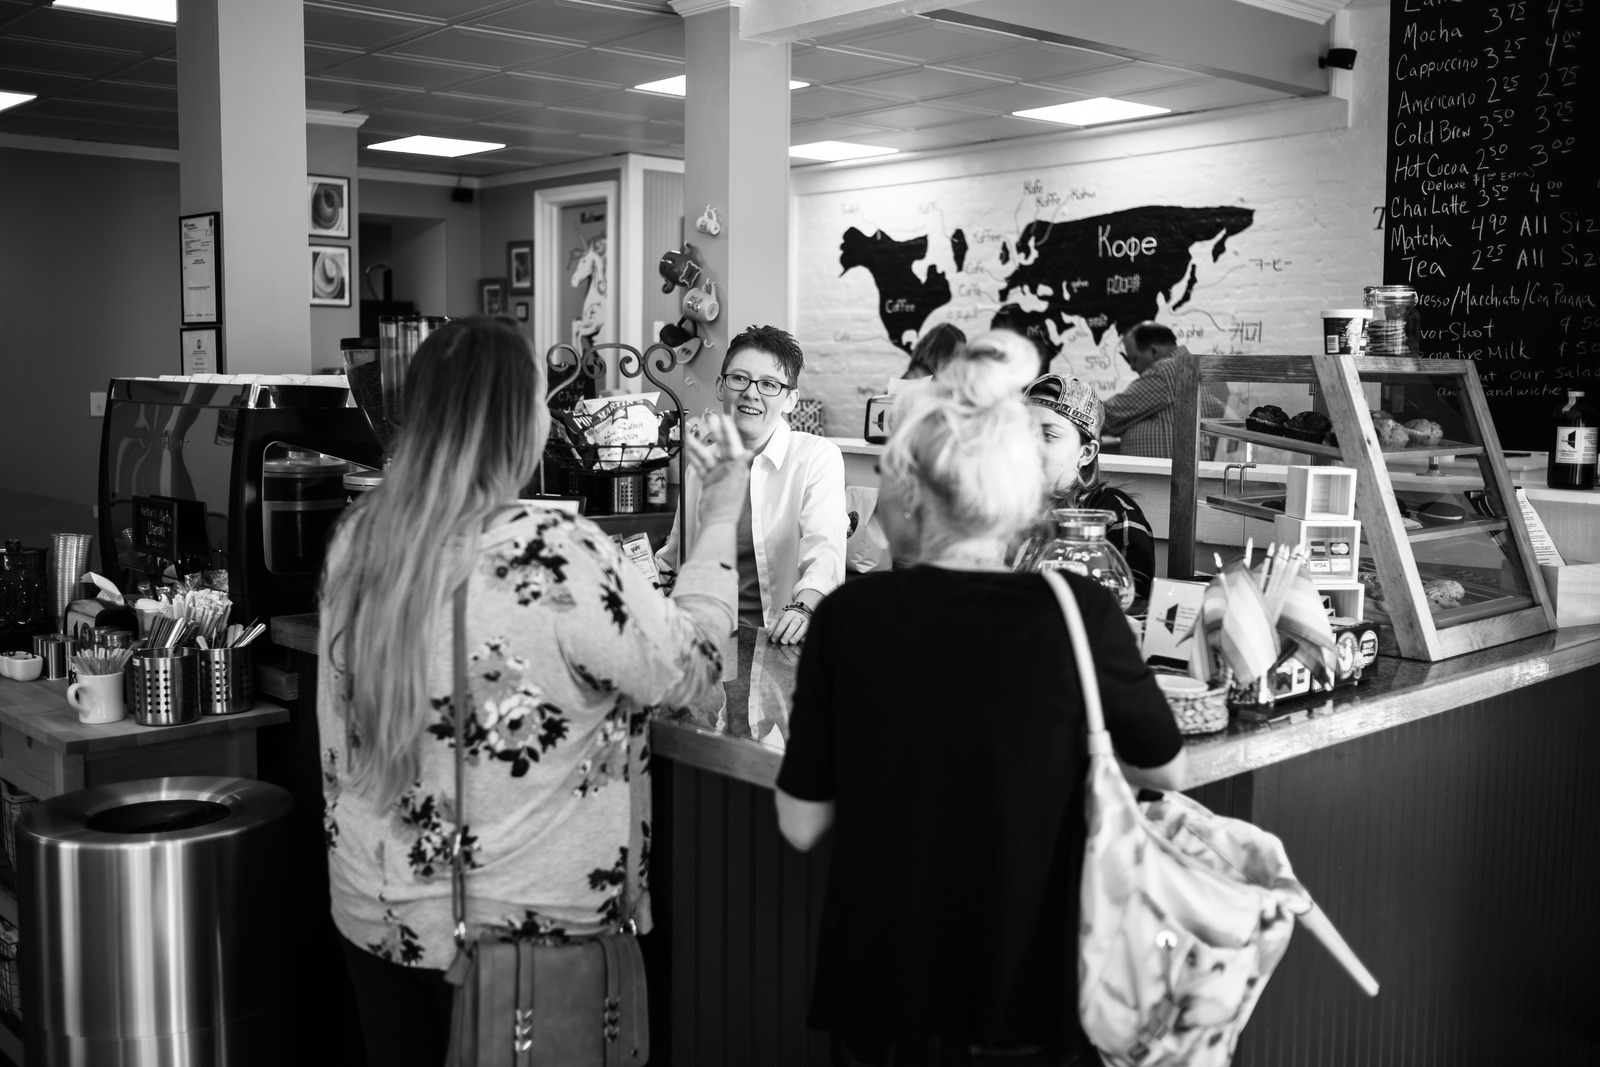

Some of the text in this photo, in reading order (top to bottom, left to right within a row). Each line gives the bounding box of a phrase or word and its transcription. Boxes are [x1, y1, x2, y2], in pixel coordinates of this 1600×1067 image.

[1403, 18, 1463, 51] Mocha
[1396, 49, 1479, 81] Cappuccino
[1397, 90, 1476, 118] Americano
[1394, 119, 1435, 147] Cold
[1439, 119, 1471, 143] Brew
[1394, 153, 1470, 184] Hot Cocoa
[1391, 195, 1427, 218] Chai
[1431, 193, 1471, 216] Latte
[1097, 224, 1158, 262] Кофе
[1391, 223, 1453, 256] Matcha
[1519, 214, 1548, 237] All
[1559, 211, 1600, 235] Siz
[1401, 255, 1447, 283] Tea
[1516, 247, 1545, 271] All
[1560, 243, 1600, 268] Siz
[884, 298, 917, 315] Coffee
[1552, 282, 1597, 309] Panna
[1419, 329, 1449, 341] vor
[1488, 338, 1532, 360] Milk
